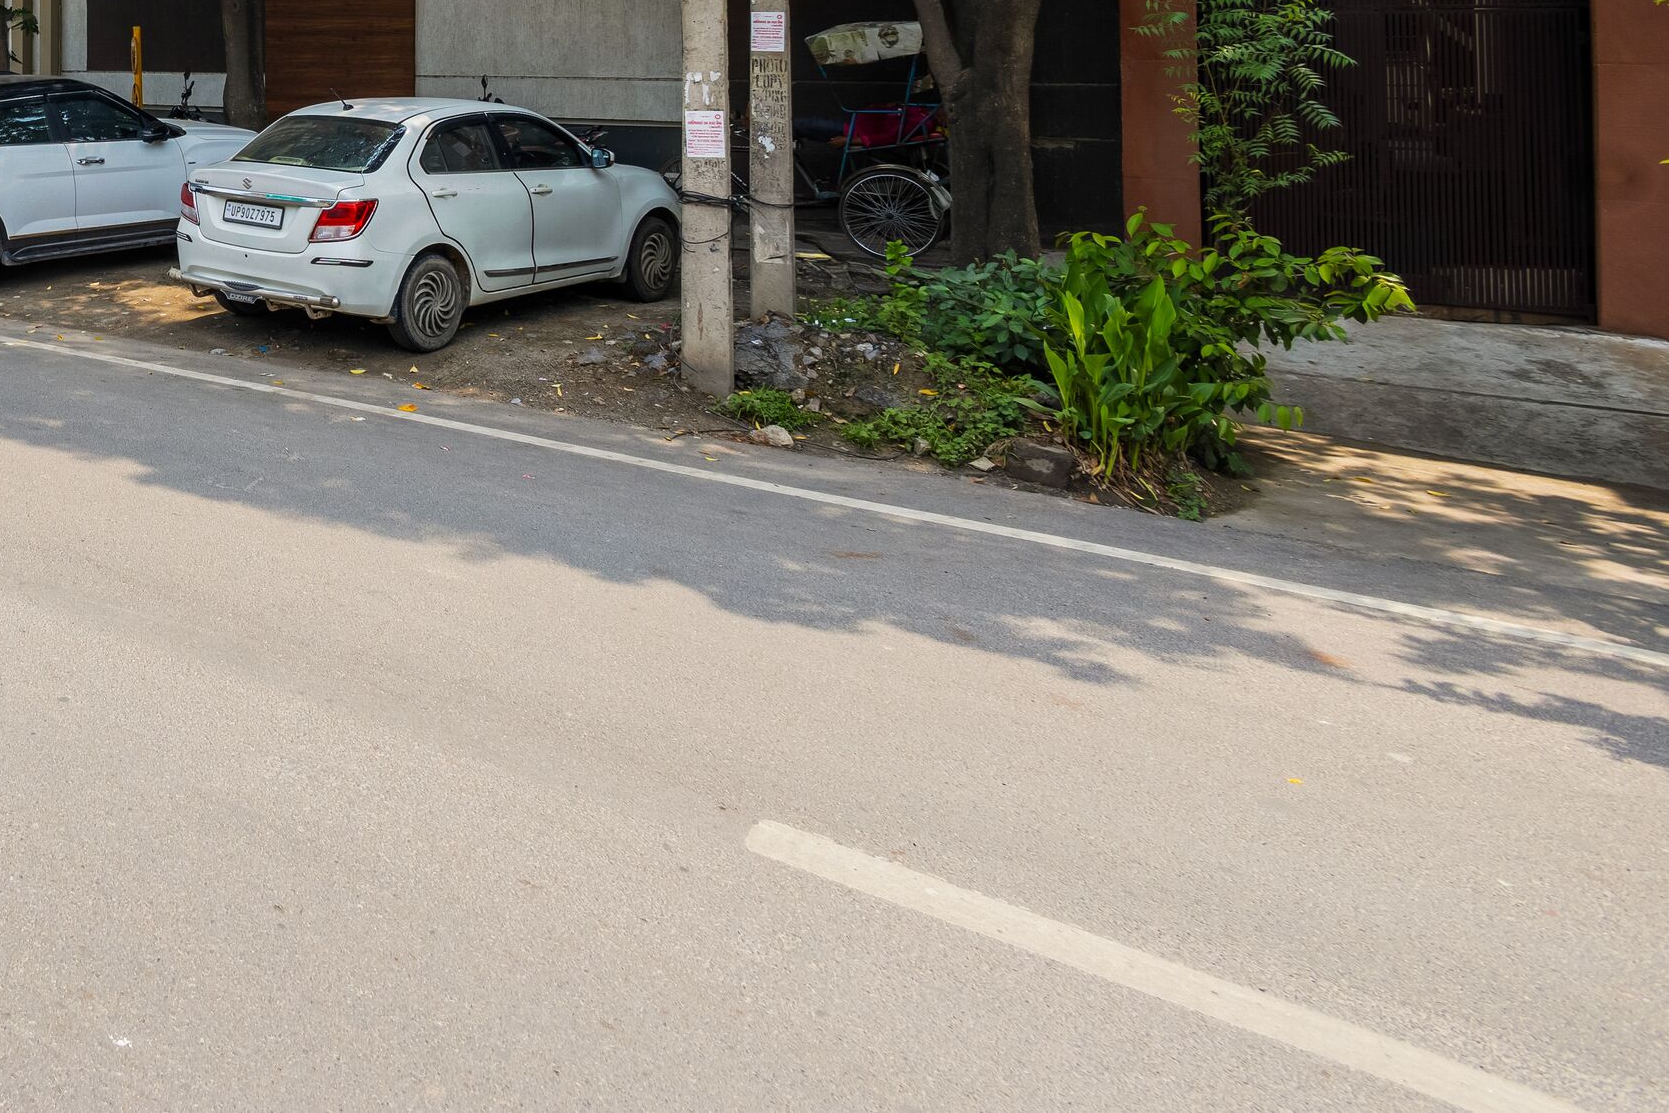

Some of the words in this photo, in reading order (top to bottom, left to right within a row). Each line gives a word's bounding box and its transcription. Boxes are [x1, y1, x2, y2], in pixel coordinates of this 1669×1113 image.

[751, 58, 787, 73] PHOTO
[755, 74, 783, 88] COPY
[230, 205, 275, 223] UP90Z7975
[230, 293, 253, 303] DZIRE
